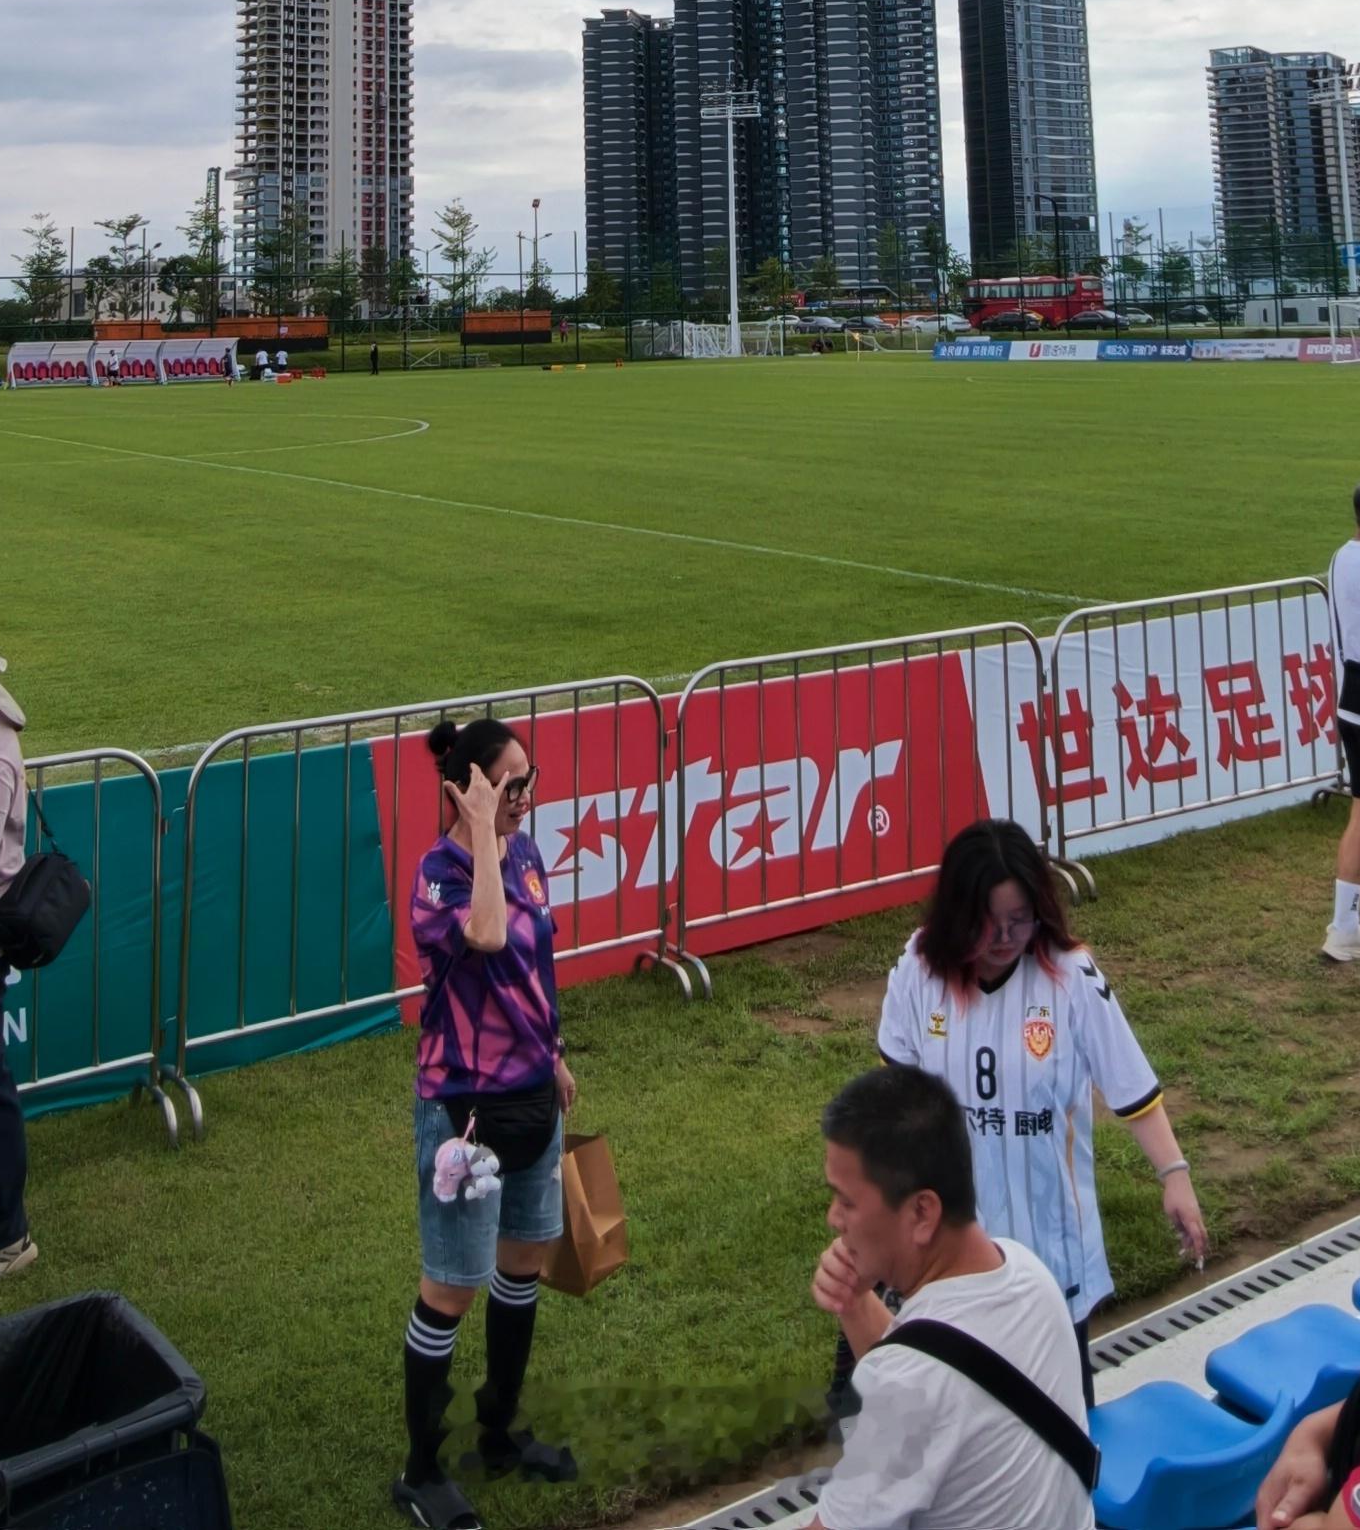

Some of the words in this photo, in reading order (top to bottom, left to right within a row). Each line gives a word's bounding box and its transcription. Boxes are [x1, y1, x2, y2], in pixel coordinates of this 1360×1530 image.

[1307, 344, 1352, 355] INSPRE
[1016, 643, 1339, 808] 世达足球
[519, 738, 903, 908] star
[975, 1046, 997, 1101] 8
